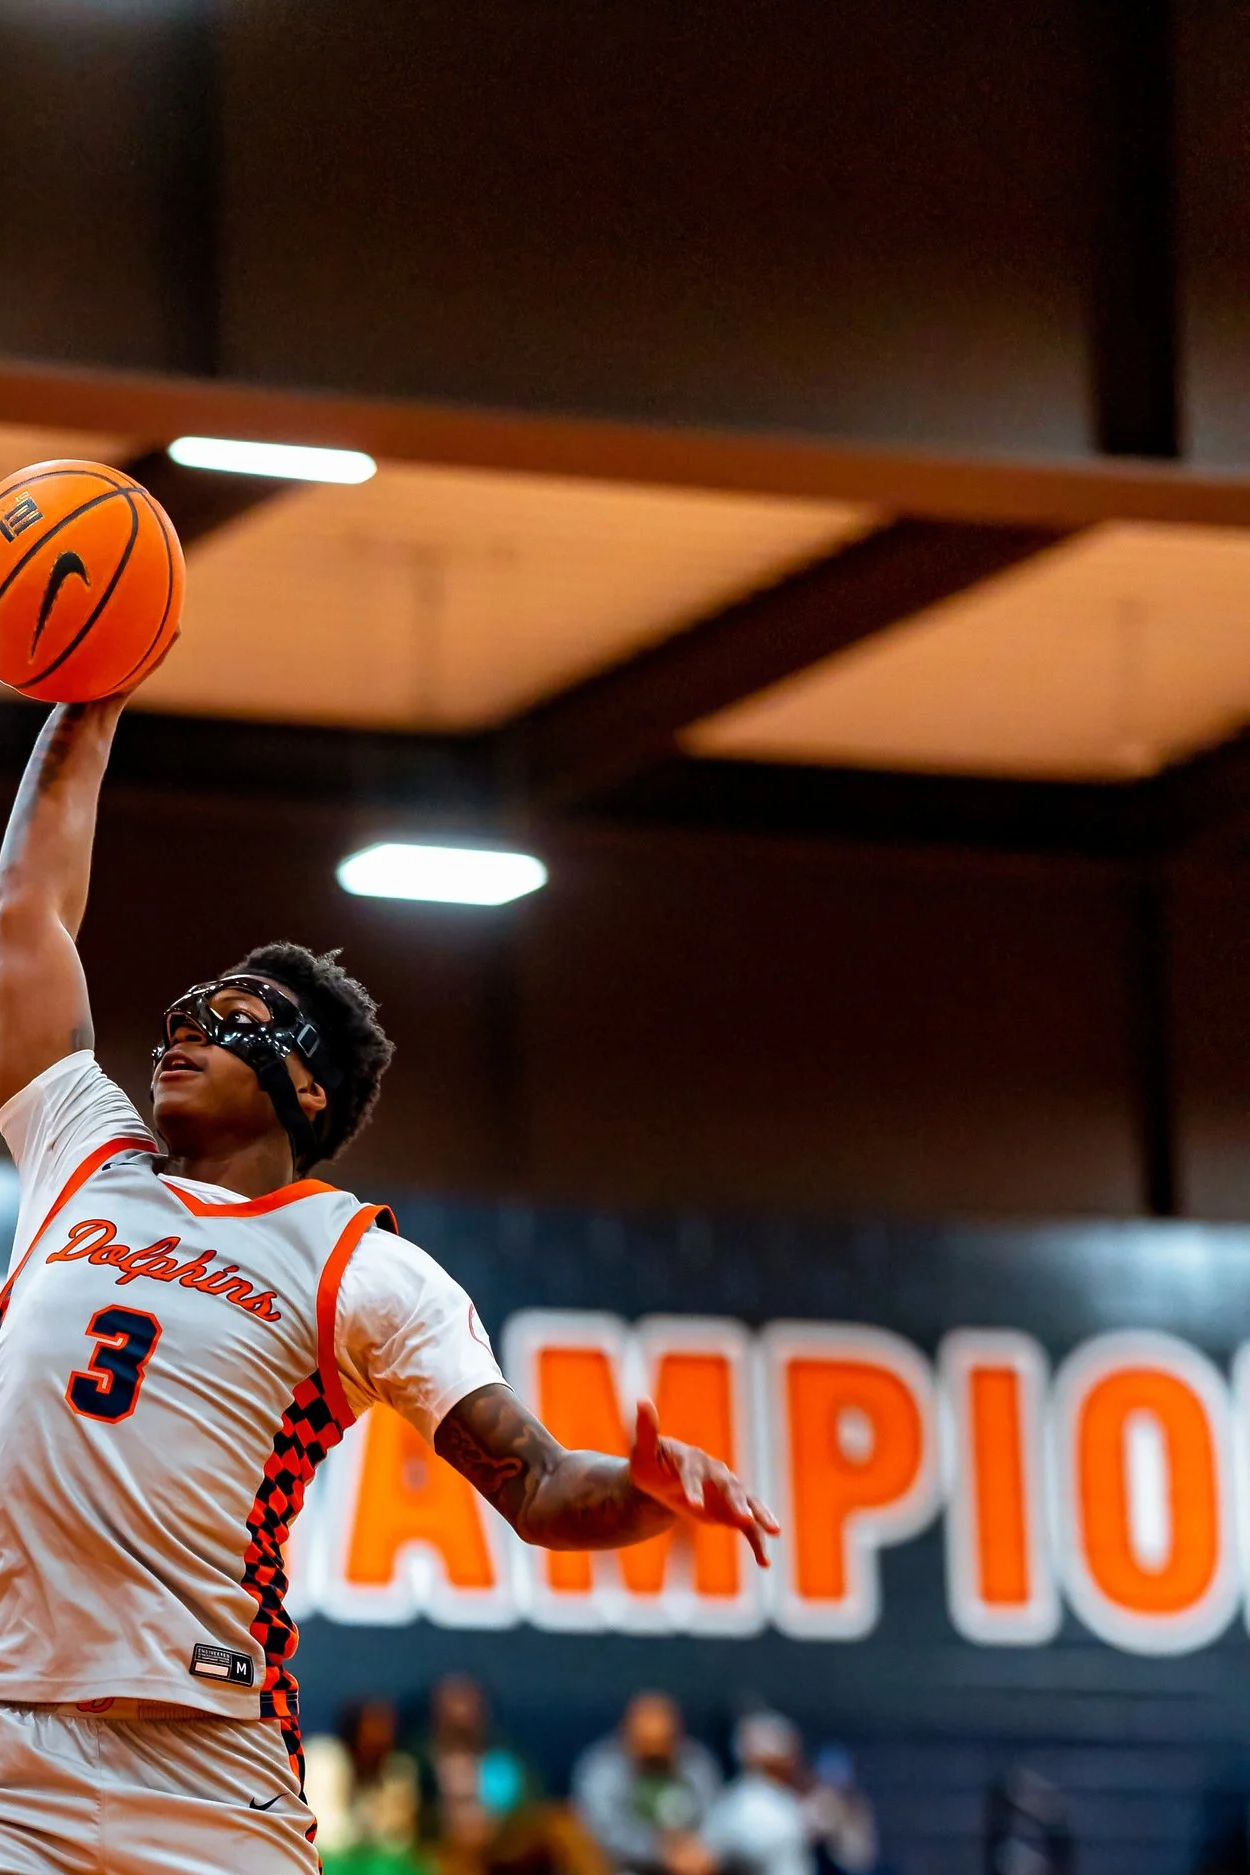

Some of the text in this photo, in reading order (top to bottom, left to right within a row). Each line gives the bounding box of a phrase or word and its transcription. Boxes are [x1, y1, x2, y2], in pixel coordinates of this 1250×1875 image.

[46, 1218, 282, 1323] Dolphins
[65, 1304, 163, 1424] 3
[236, 1661, 247, 1676] M
